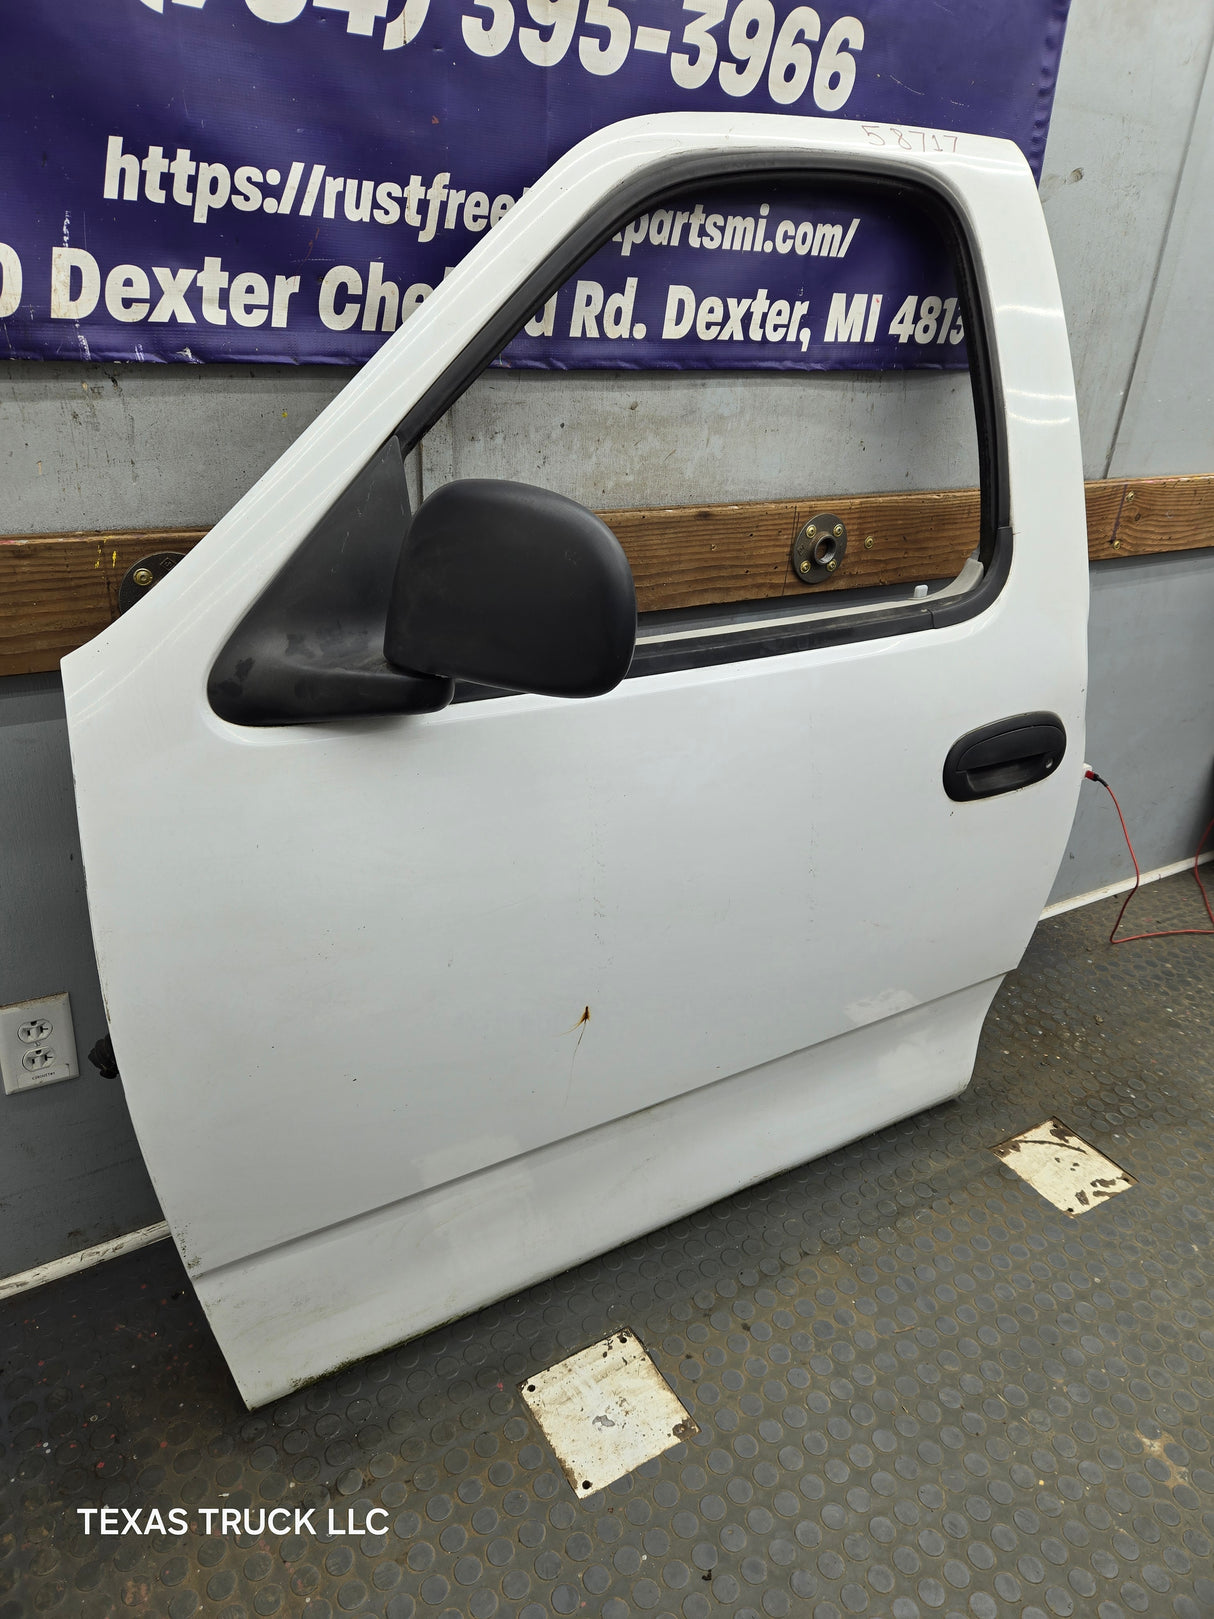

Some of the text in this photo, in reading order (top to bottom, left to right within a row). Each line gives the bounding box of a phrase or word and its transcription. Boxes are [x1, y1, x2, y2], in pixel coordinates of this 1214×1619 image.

[461, 0, 865, 111] 395-3966
[861, 125, 958, 152] 58717
[50, 246, 301, 328] Dexter
[569, 277, 647, 340] Rd.
[662, 285, 811, 352] Dexter,
[824, 293, 883, 342] MI
